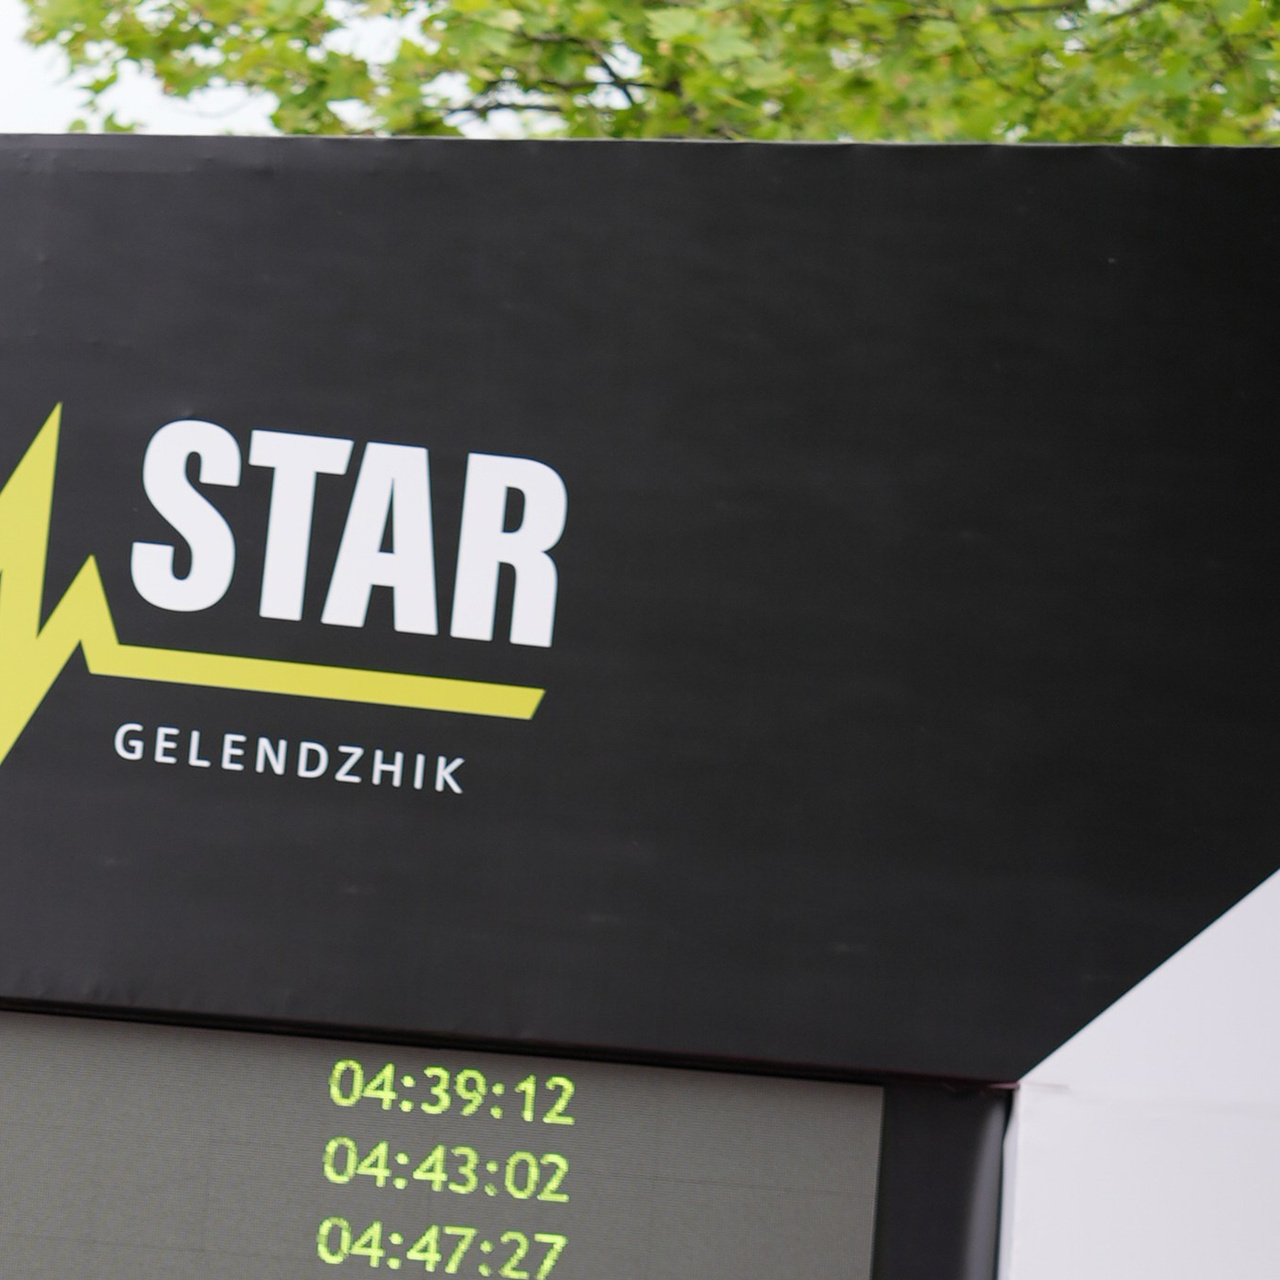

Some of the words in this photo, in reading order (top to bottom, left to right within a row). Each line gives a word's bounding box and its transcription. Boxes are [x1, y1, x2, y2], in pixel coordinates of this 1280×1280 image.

[130, 419, 567, 649] STAR
[113, 723, 465, 795] GELENDZHIK
[328, 1058, 576, 1126] 04:39:12
[322, 1136, 570, 1203] 04:43:02
